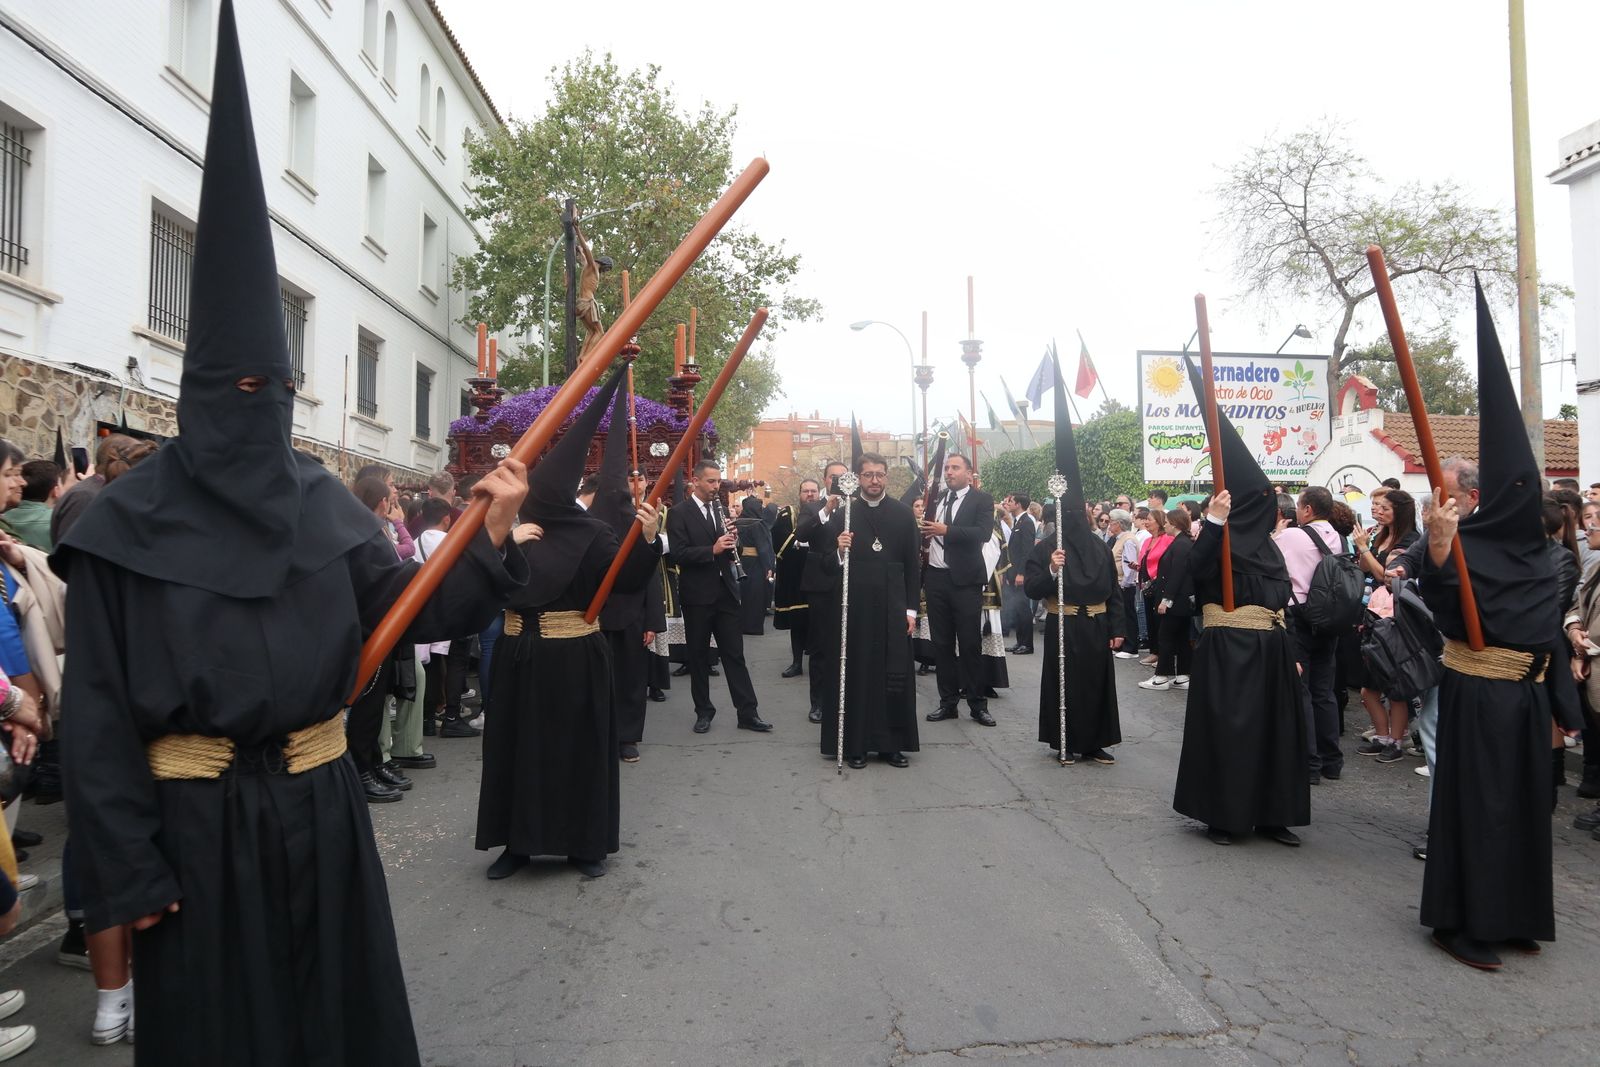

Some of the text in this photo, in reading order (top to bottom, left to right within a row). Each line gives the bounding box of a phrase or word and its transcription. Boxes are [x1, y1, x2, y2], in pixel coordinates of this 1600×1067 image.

[1176, 357, 1185, 372] el
[1190, 362, 1280, 383] ernadero
[1214, 385, 1273, 400] ntro de Ocio
[1145, 403, 1287, 420] Los MOTADITOS
[1296, 403, 1326, 414] HUELVA
